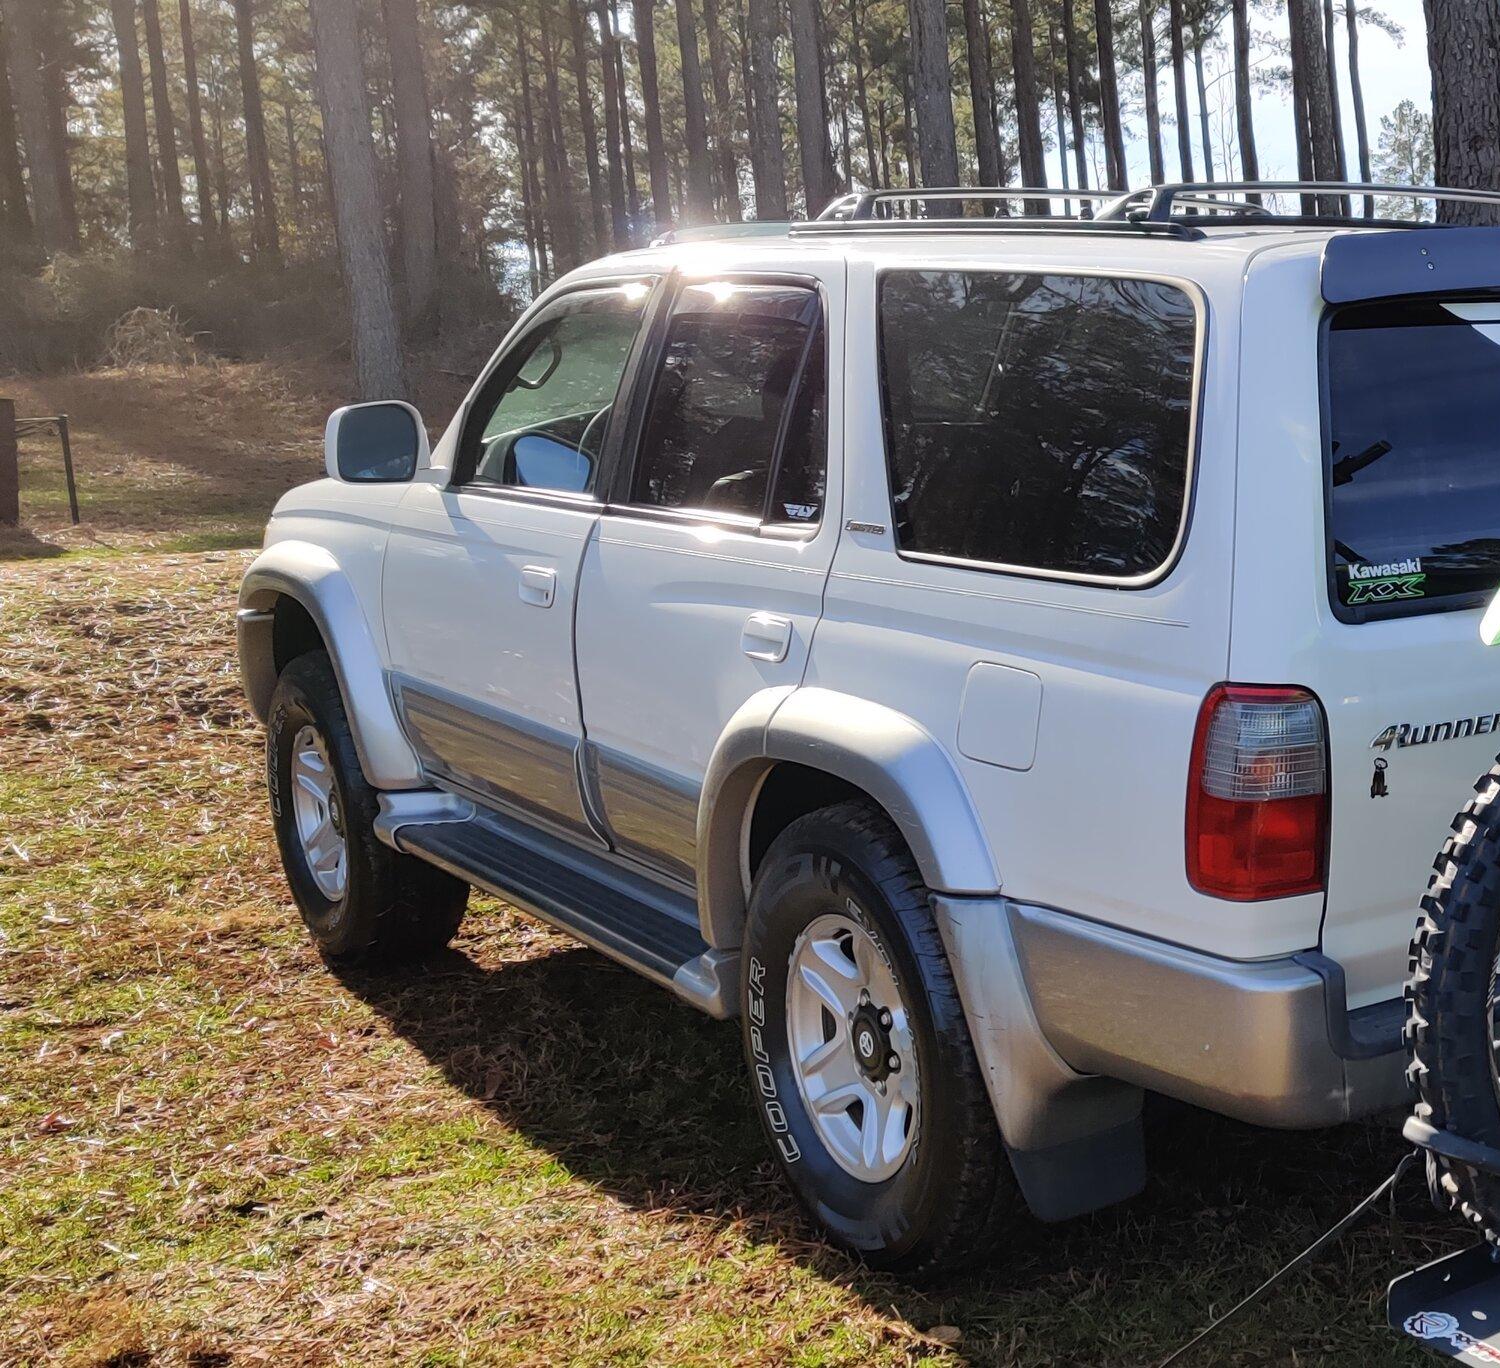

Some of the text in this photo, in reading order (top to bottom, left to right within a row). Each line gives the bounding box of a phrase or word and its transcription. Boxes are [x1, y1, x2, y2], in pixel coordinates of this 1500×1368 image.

[1348, 558, 1422, 579] Kawasaki
[1347, 573, 1426, 605] KX
[749, 957, 801, 1163] COOPER
